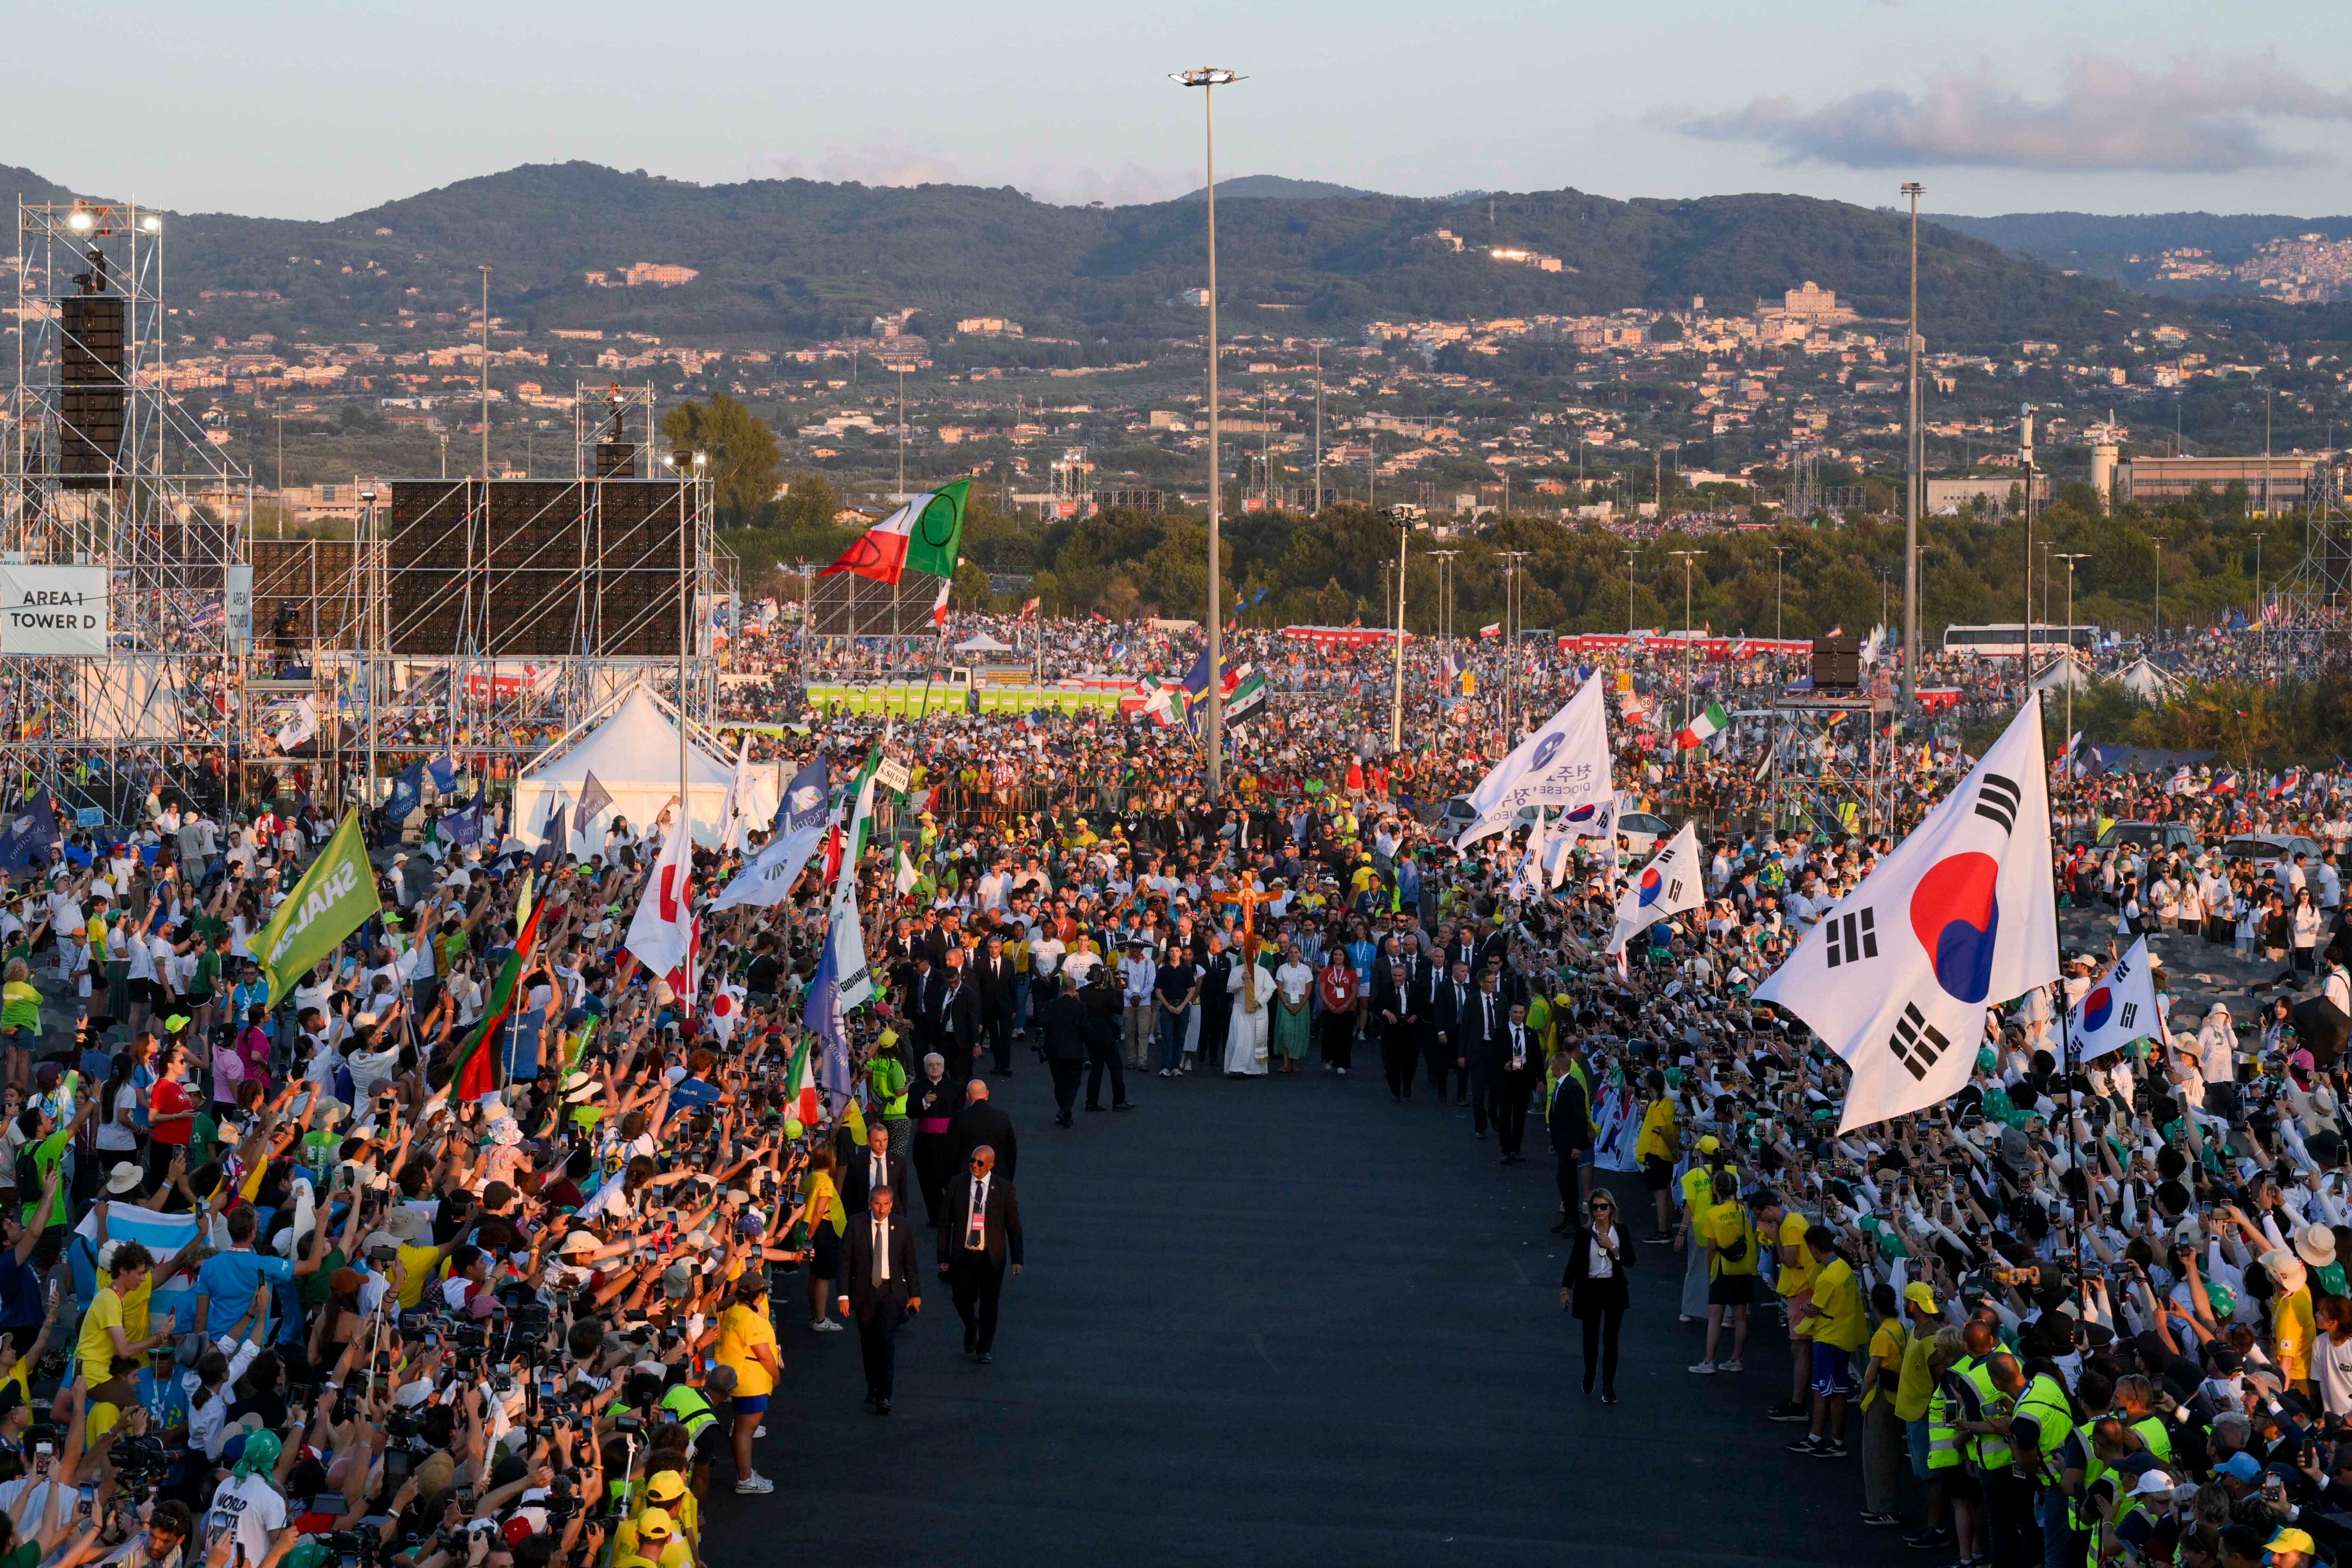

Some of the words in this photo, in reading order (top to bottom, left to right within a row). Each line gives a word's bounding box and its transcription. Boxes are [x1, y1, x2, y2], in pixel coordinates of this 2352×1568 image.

[23, 591, 72, 606] AREA
[77, 593, 82, 606] 1
[233, 592, 245, 605] AREA
[10, 613, 77, 629] TOWER
[83, 615, 96, 629] D
[879, 767, 906, 786] S.SILVIA
[505, 1023, 527, 1032] segimi
